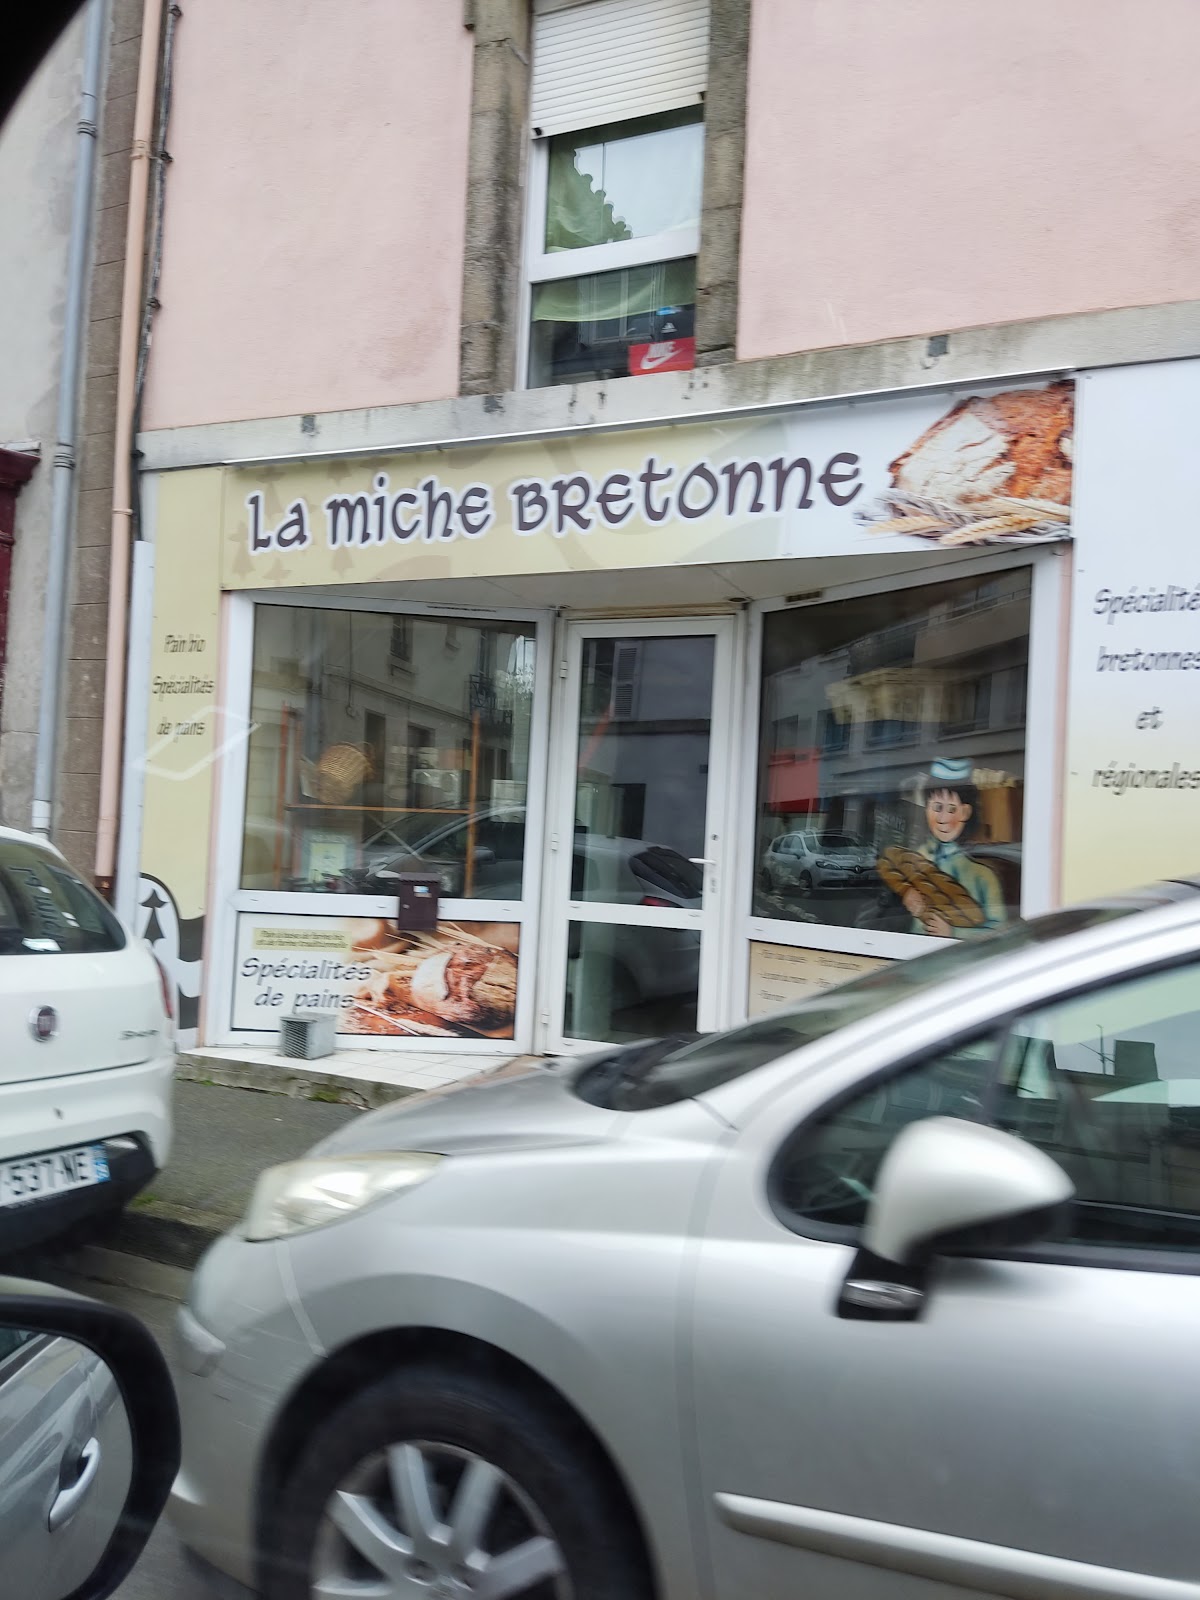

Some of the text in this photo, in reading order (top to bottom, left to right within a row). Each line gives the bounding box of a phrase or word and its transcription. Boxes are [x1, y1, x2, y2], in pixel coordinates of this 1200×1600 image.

[249, 494, 307, 550] La
[327, 475, 491, 544] miche
[1135, 705, 1163, 730] et
[241, 957, 372, 985] Spécialités
[254, 987, 355, 1014] de pains
